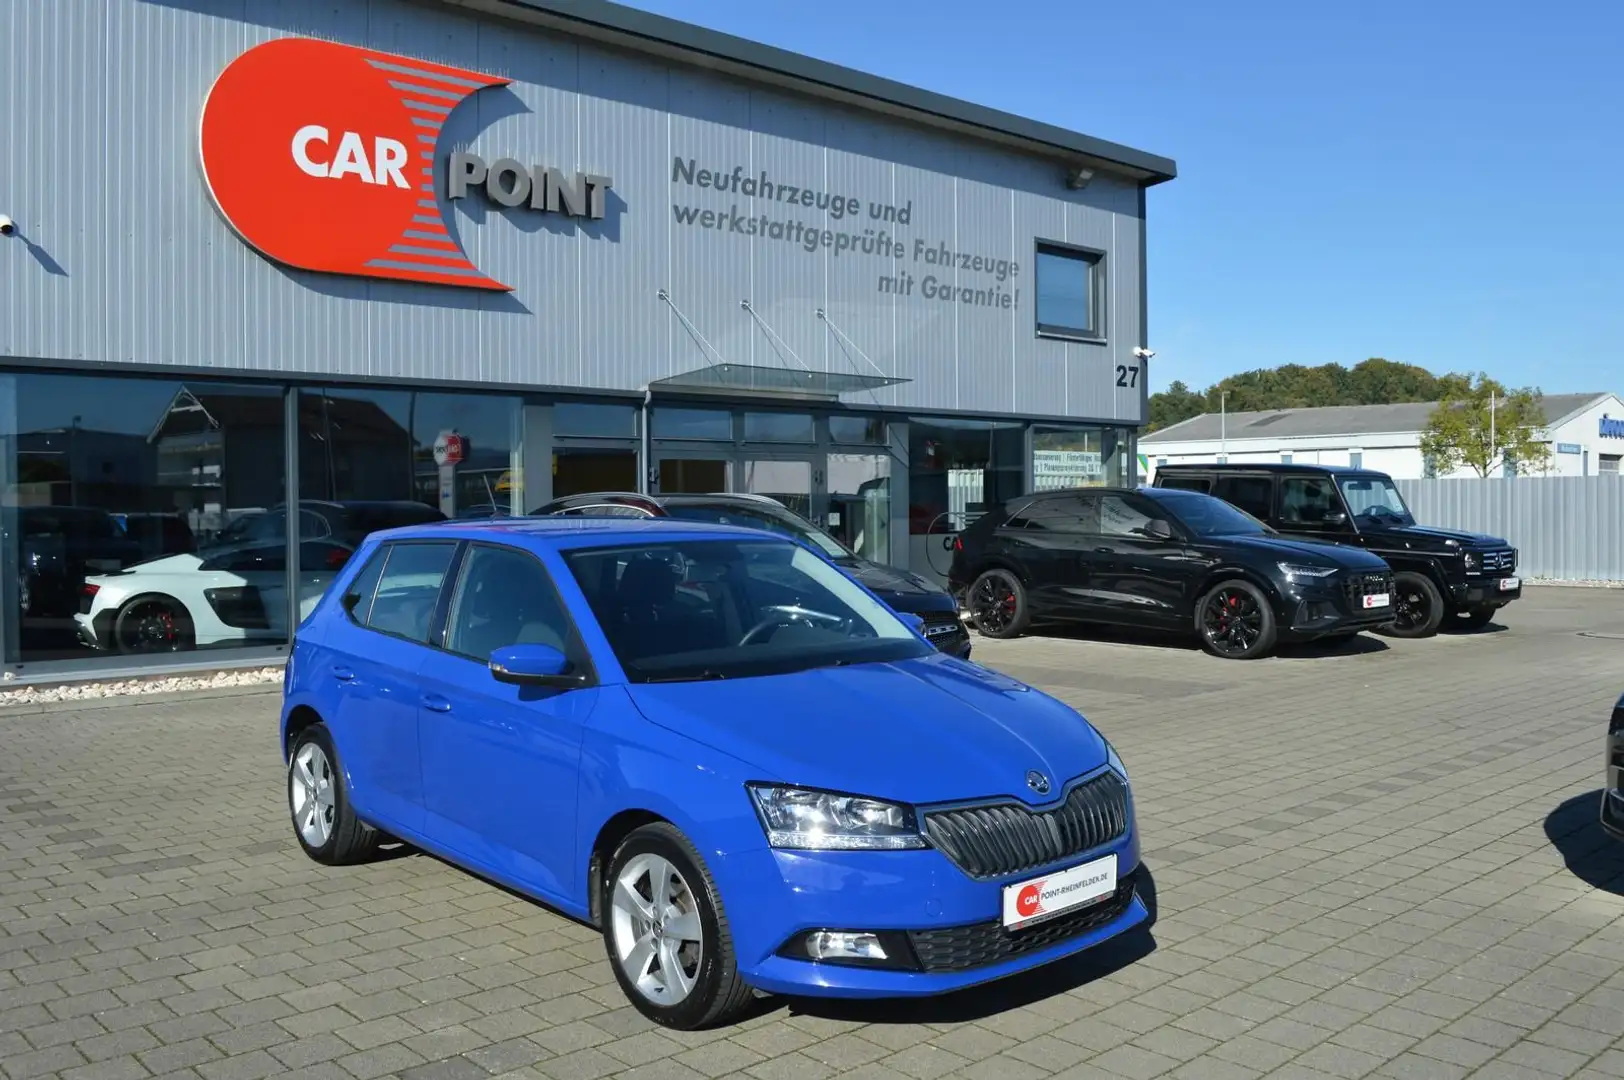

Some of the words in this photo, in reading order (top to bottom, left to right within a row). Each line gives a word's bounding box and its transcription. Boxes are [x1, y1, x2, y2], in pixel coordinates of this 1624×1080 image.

[291, 124, 411, 189] CAR
[448, 151, 613, 219] POINT
[672, 156, 860, 220] Neufahrzeuge
[869, 200, 912, 225] und
[673, 204, 905, 259] werkstattgeprüfte
[913, 238, 1019, 282] Fahrzeuge
[878, 270, 913, 296] mit
[921, 275, 1020, 310] Garantie!
[1116, 364, 1139, 388] 27
[1024, 895, 1038, 905] CAR
